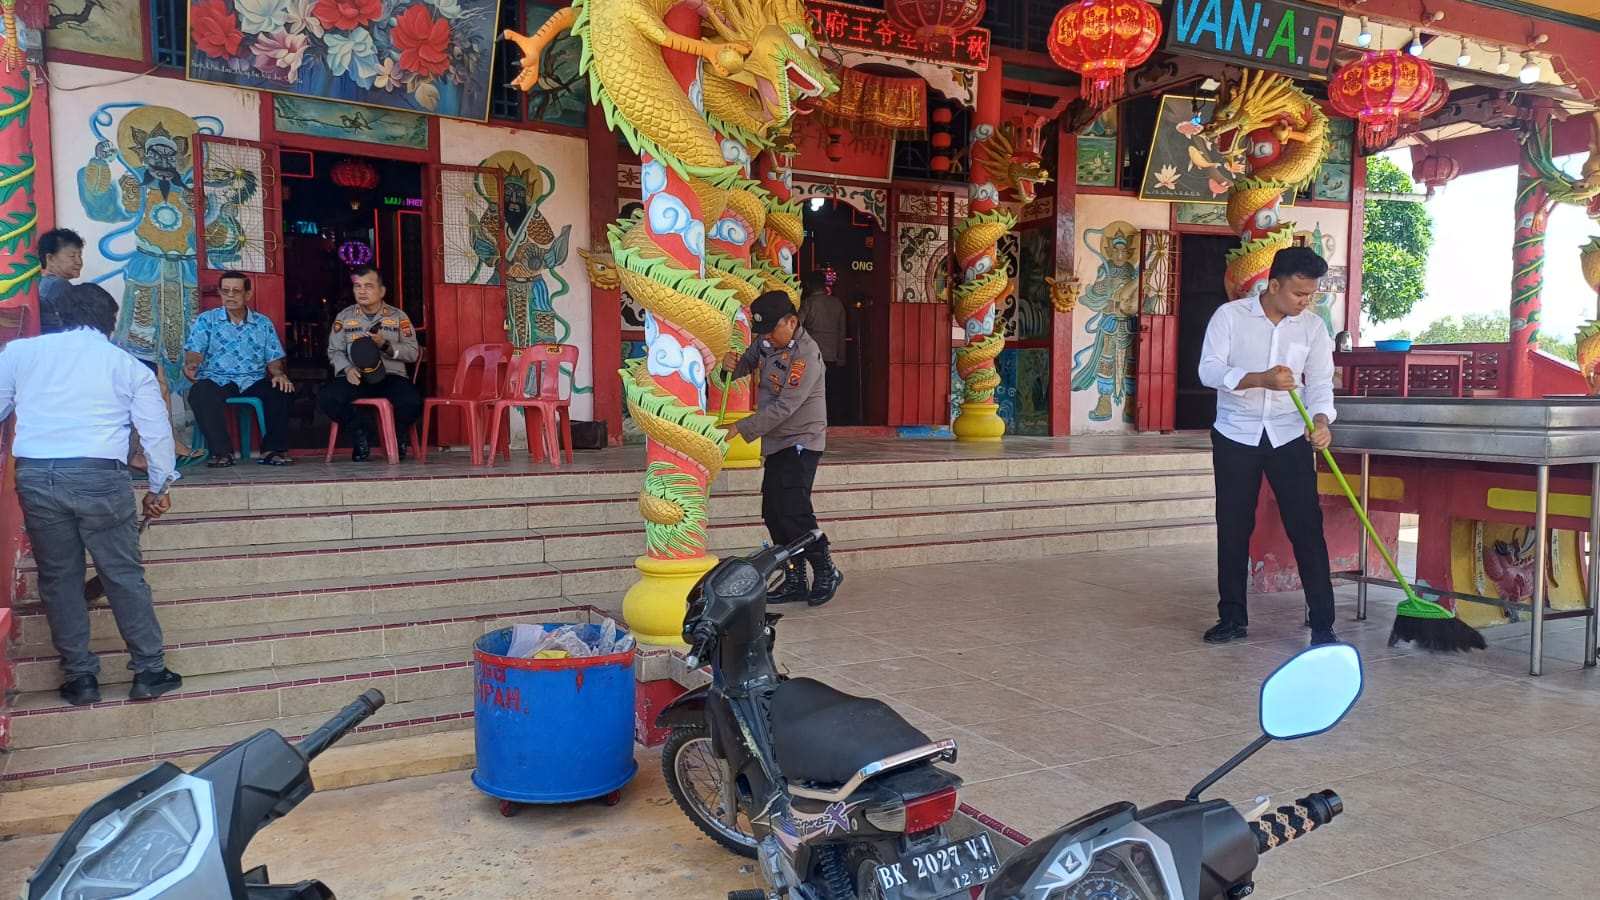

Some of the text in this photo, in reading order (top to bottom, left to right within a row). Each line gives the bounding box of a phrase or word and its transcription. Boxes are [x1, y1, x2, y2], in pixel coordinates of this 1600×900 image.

[851, 260, 874, 271] ONG
[878, 862, 908, 890] BK
[912, 845, 961, 878] 2027
